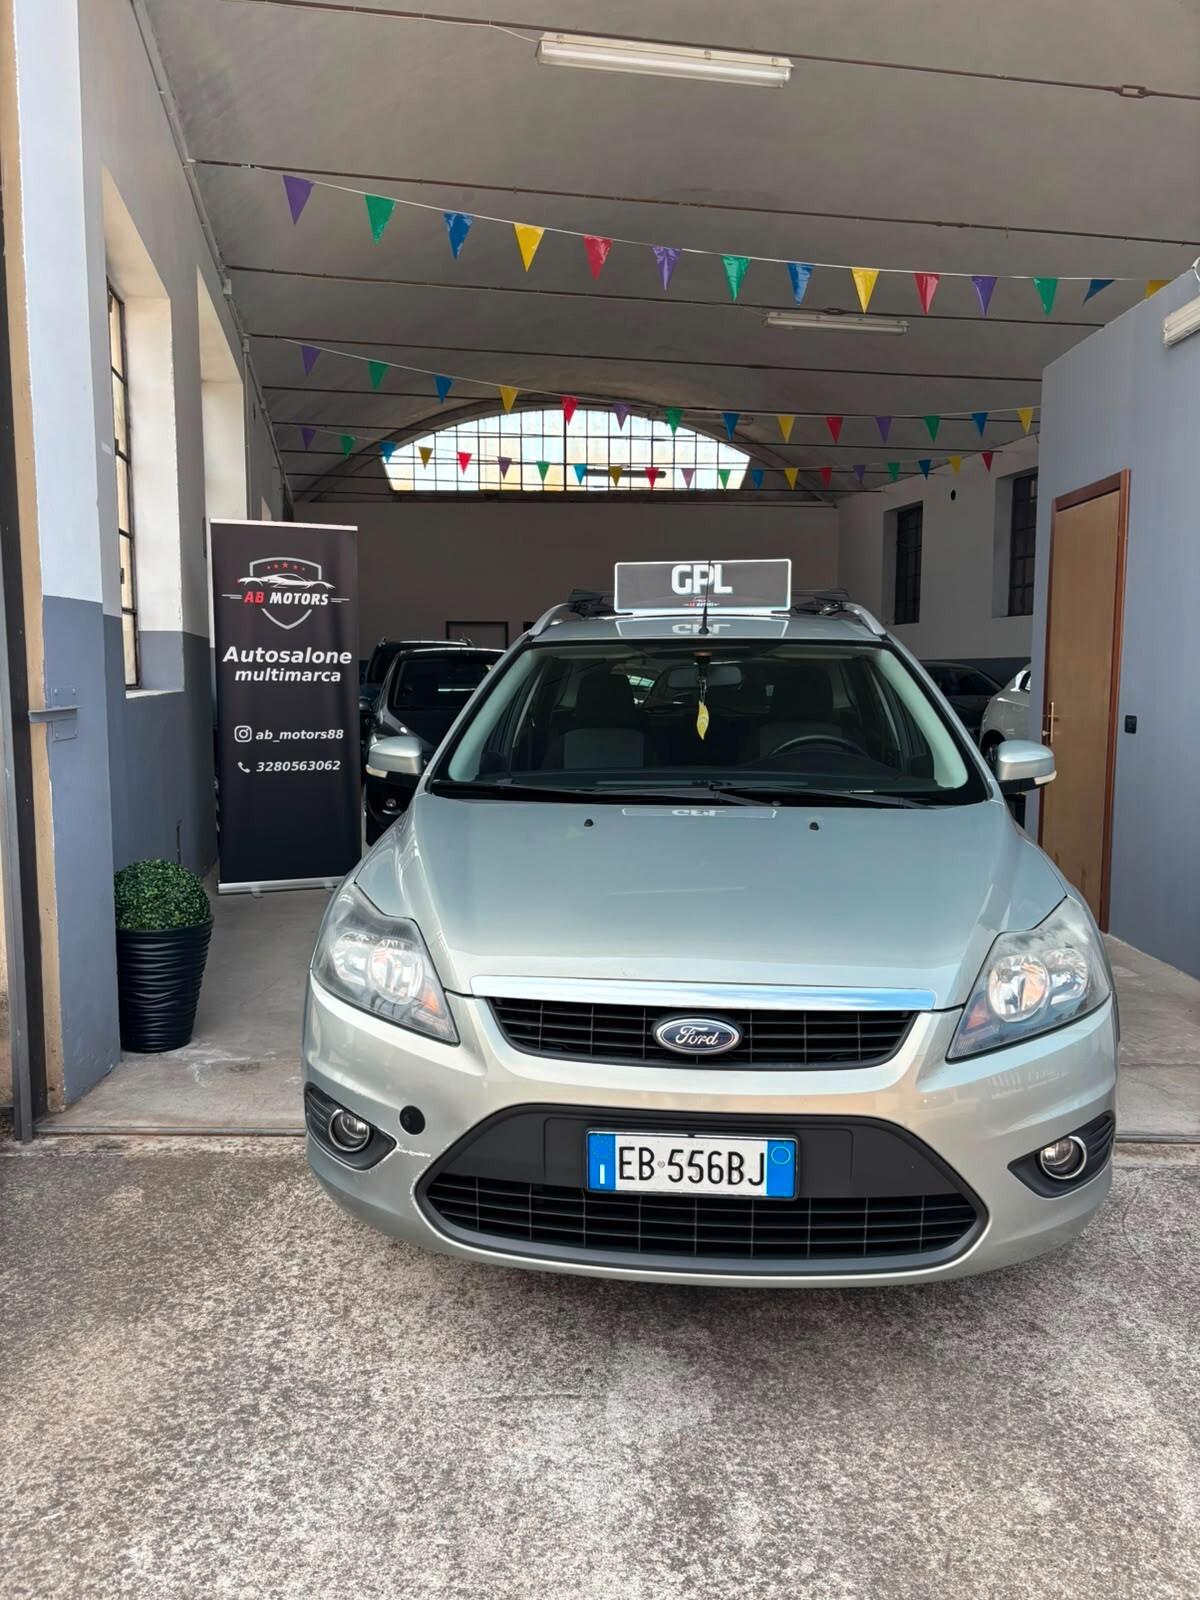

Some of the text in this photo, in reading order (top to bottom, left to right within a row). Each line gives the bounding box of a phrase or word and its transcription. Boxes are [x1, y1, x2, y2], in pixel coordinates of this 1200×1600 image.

[671, 564, 733, 595] GPL
[244, 591, 329, 606] AB MOTORS
[223, 646, 352, 664] Autosalone
[234, 668, 341, 683] multimarca
[255, 729, 344, 742] ab_motors88
[256, 760, 341, 772] 3280563062
[675, 1025, 719, 1045] Ford
